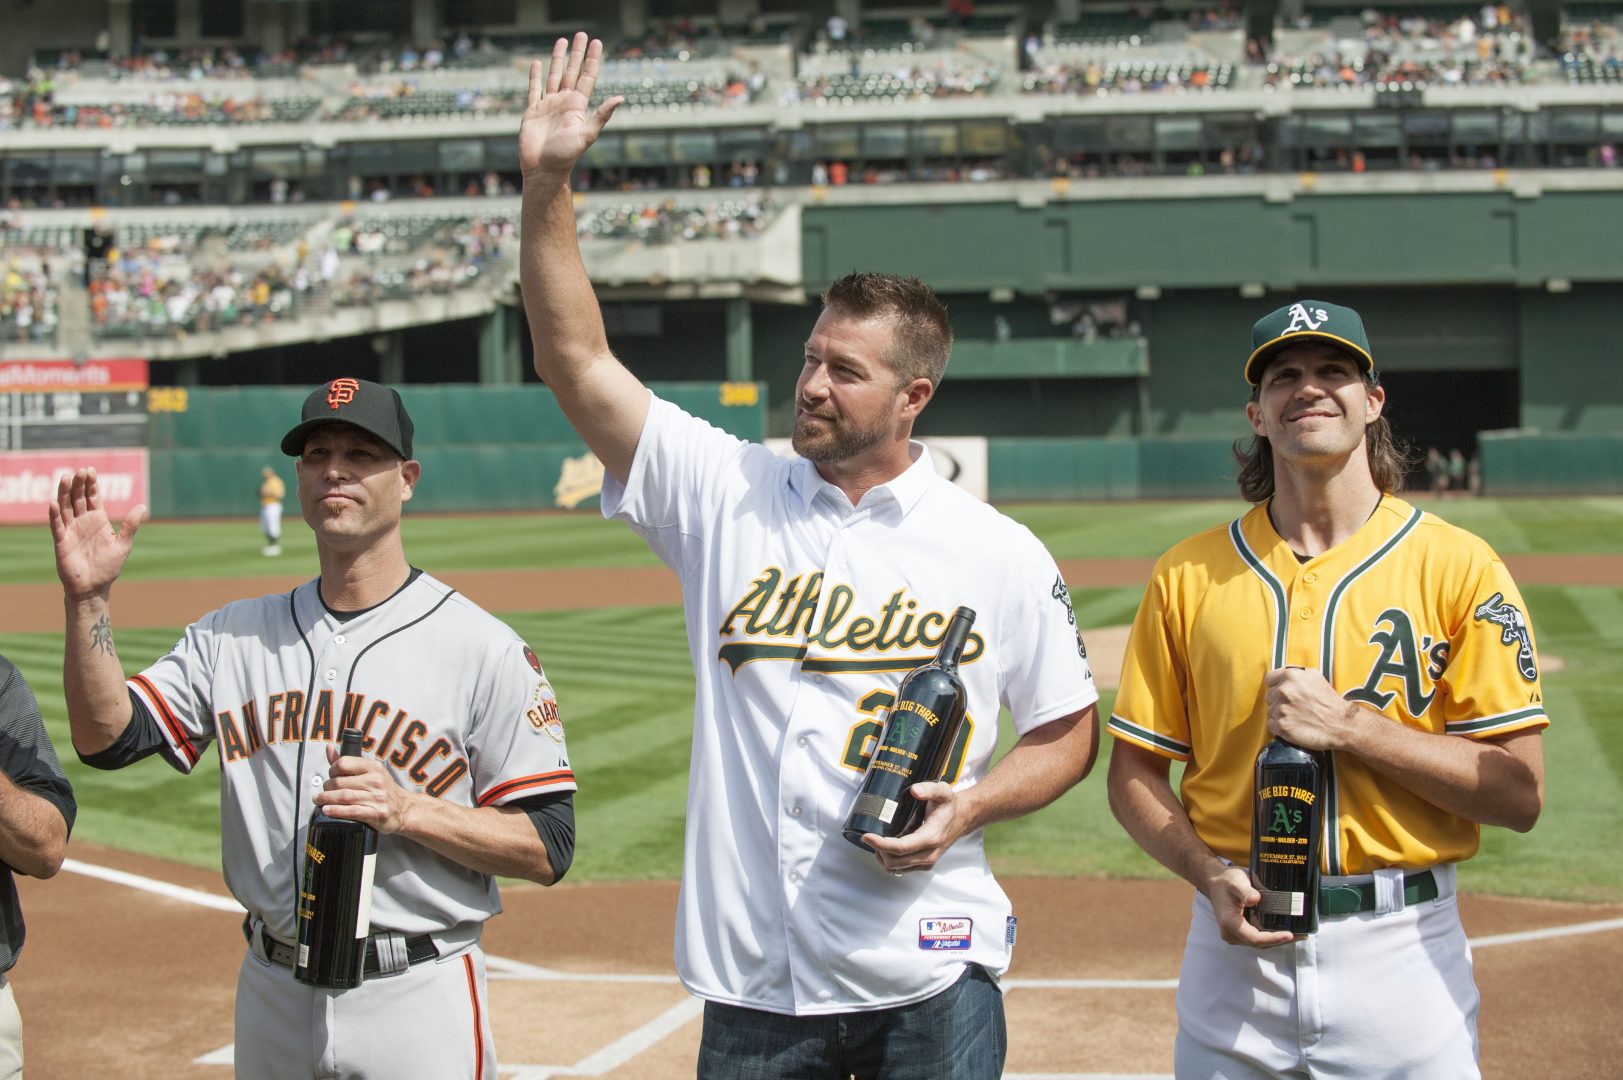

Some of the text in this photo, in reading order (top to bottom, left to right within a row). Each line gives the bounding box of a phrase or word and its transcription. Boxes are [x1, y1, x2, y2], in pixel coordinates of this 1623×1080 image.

[1281, 303, 1329, 337] A's
[1342, 608, 1451, 718] A's
[900, 700, 915, 711] BIG
[914, 703, 940, 727] THREE
[217, 690, 469, 799] AN FRANCISCO
[840, 688, 975, 788] 2
[1272, 785, 1289, 797] BIG
[1290, 786, 1316, 806] THREE
[1267, 802, 1303, 833] A's
